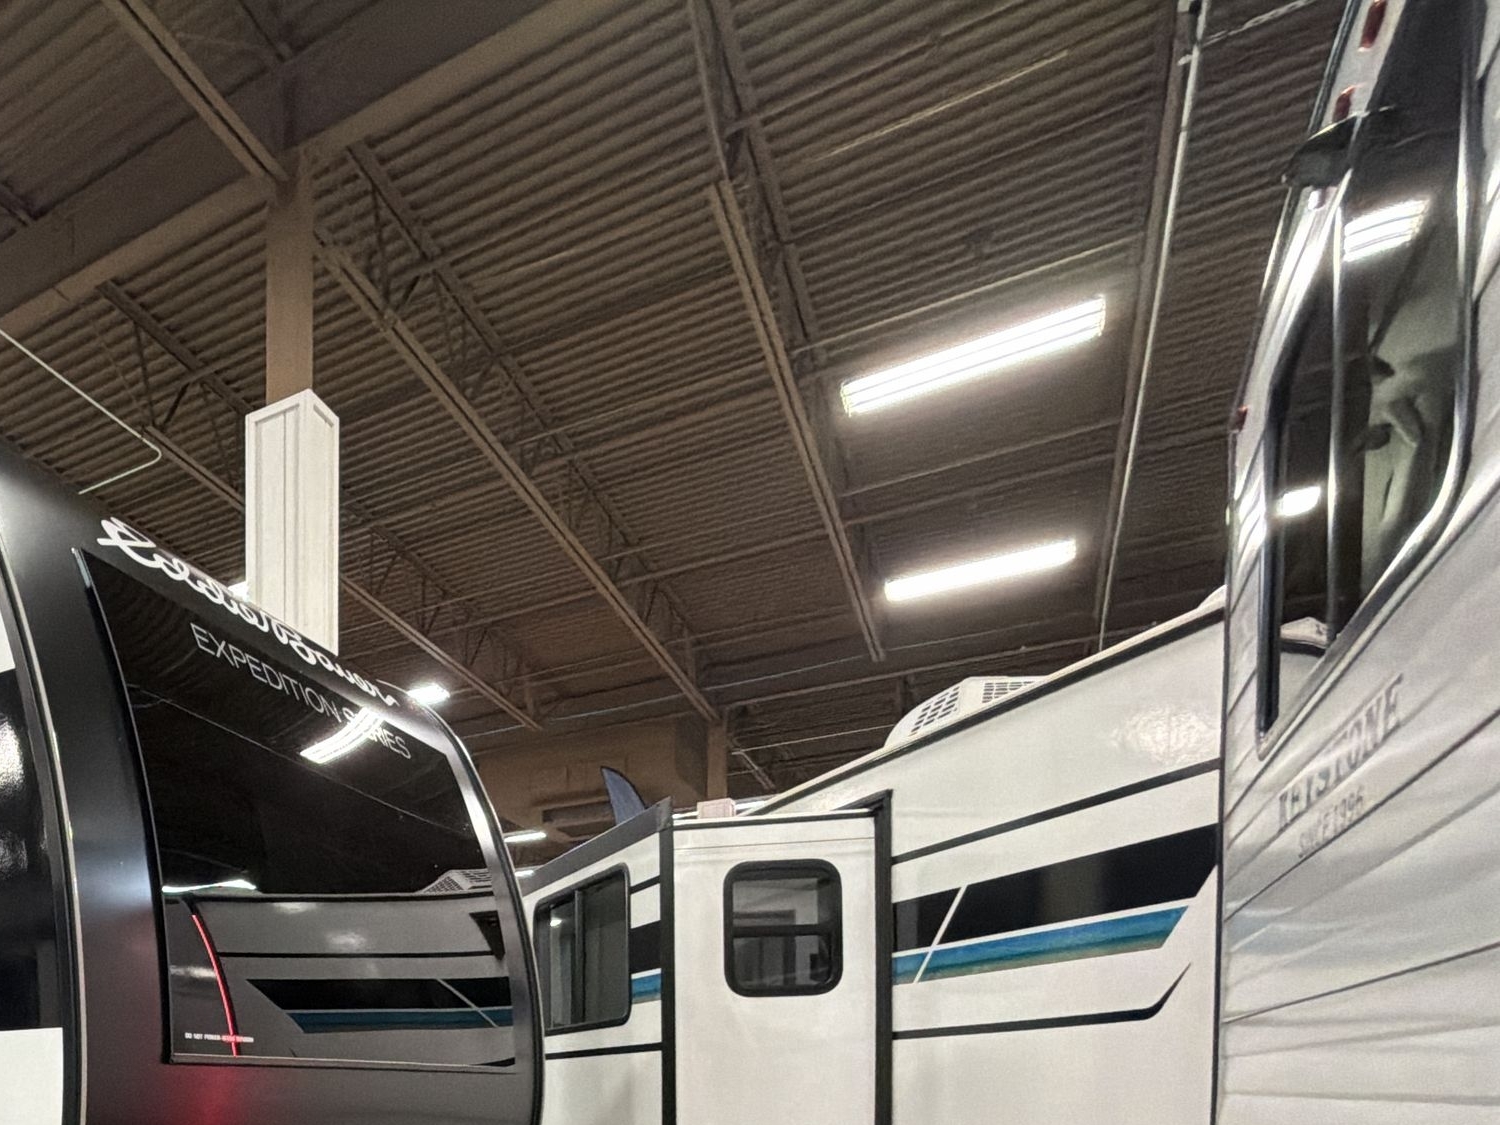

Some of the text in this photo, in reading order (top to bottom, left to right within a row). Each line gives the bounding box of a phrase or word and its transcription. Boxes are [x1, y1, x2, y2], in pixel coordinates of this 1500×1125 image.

[97, 516, 400, 708] Eddie Bauer
[190, 622, 413, 760] EXPEDITION SRIES
